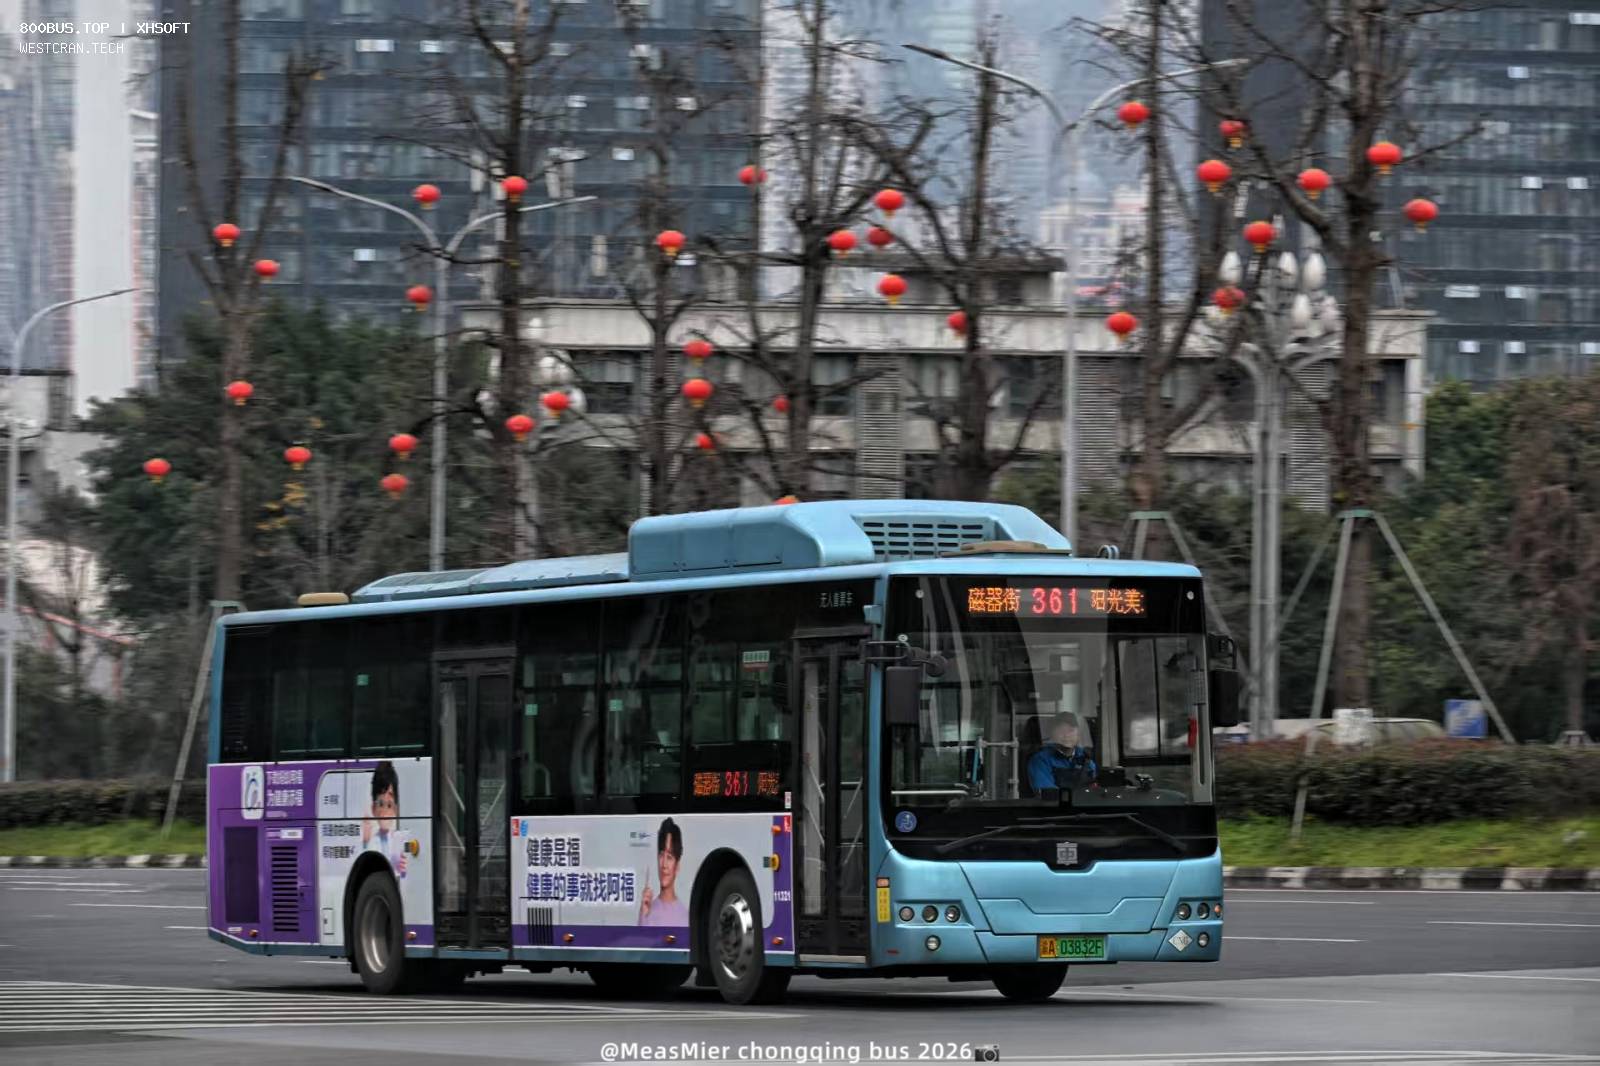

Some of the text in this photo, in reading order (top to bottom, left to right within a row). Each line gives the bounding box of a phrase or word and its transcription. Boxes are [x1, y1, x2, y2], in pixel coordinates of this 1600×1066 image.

[1031, 588, 1077, 614] 361
[1090, 588, 1145, 614] 阳光美
[724, 771, 749, 797] 361
[527, 838, 580, 867] 健康是福
[526, 872, 635, 902] 健康的事就找阿福
[1060, 939, 1103, 955] 03832F
